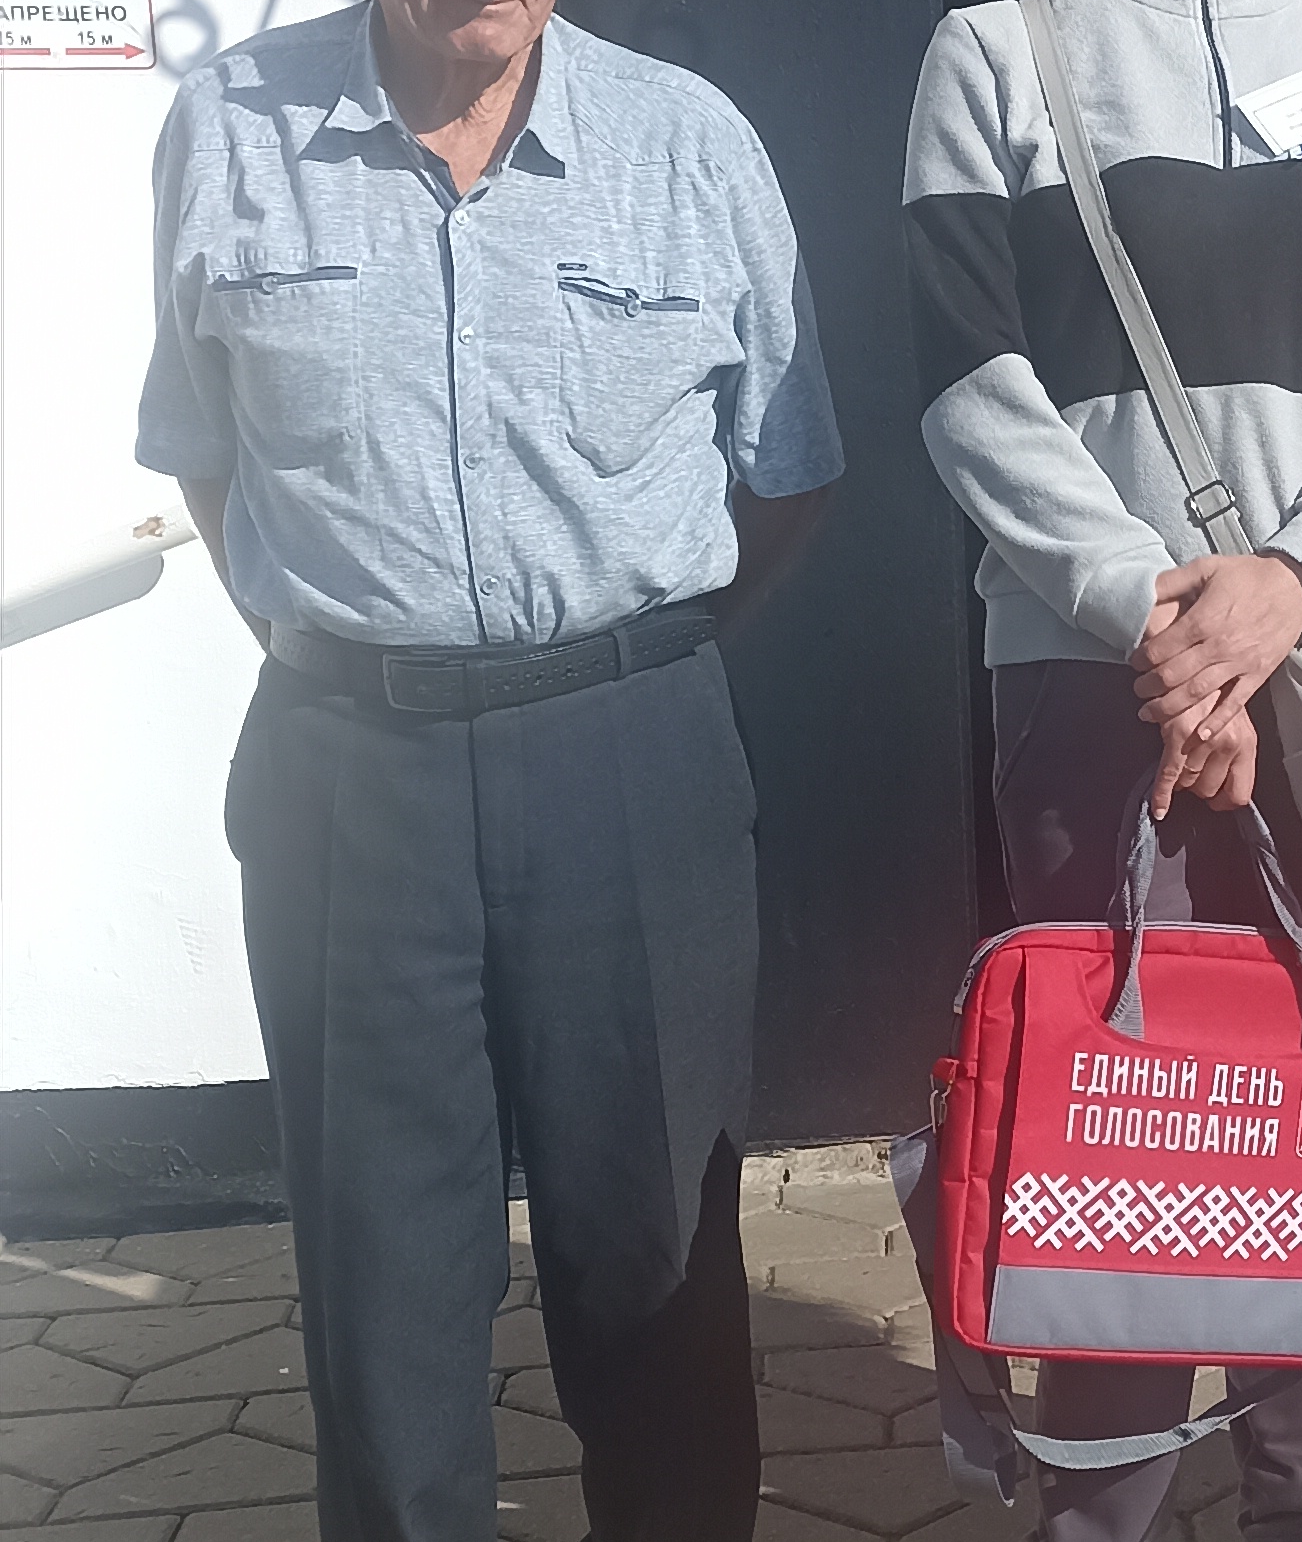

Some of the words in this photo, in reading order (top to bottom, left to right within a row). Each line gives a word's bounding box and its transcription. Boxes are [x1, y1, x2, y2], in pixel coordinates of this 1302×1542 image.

[20, 35, 32, 46] м
[77, 30, 96, 46] 15
[101, 35, 114, 46] м
[1070, 1051, 1198, 1101] ЕДИНЫЙ
[1207, 1063, 1284, 1107] ДЕНЬ
[1065, 1103, 1280, 1157] ГОЛОСОВАНИЯ
